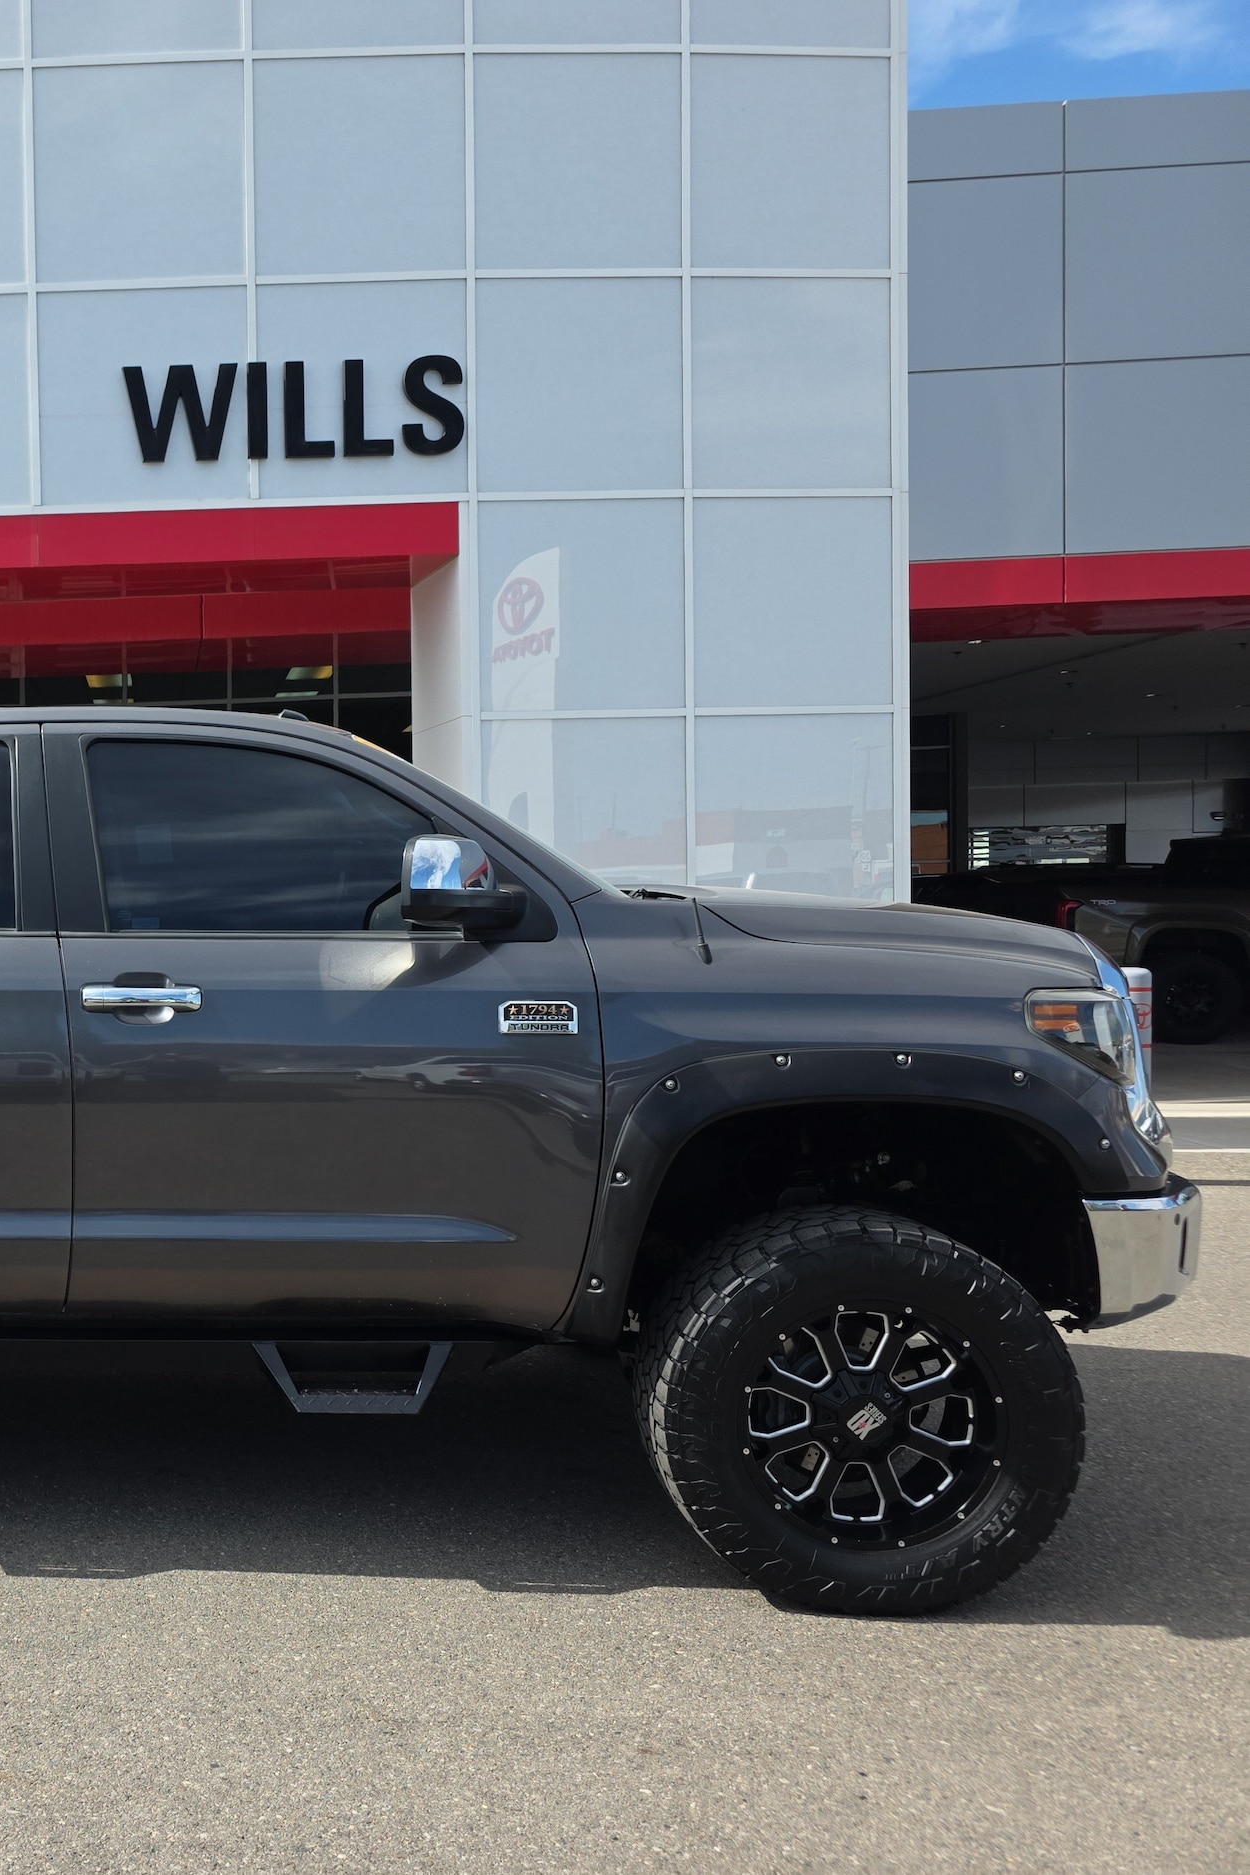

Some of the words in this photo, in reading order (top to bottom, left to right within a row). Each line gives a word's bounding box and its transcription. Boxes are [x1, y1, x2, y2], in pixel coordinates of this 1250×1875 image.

[122, 354, 465, 464] WILLS
[520, 1004, 558, 1015] 1794
[510, 1023, 569, 1031] TUNDRA
[846, 1409, 881, 1440] XD
[864, 1402, 887, 1425] SERIES
